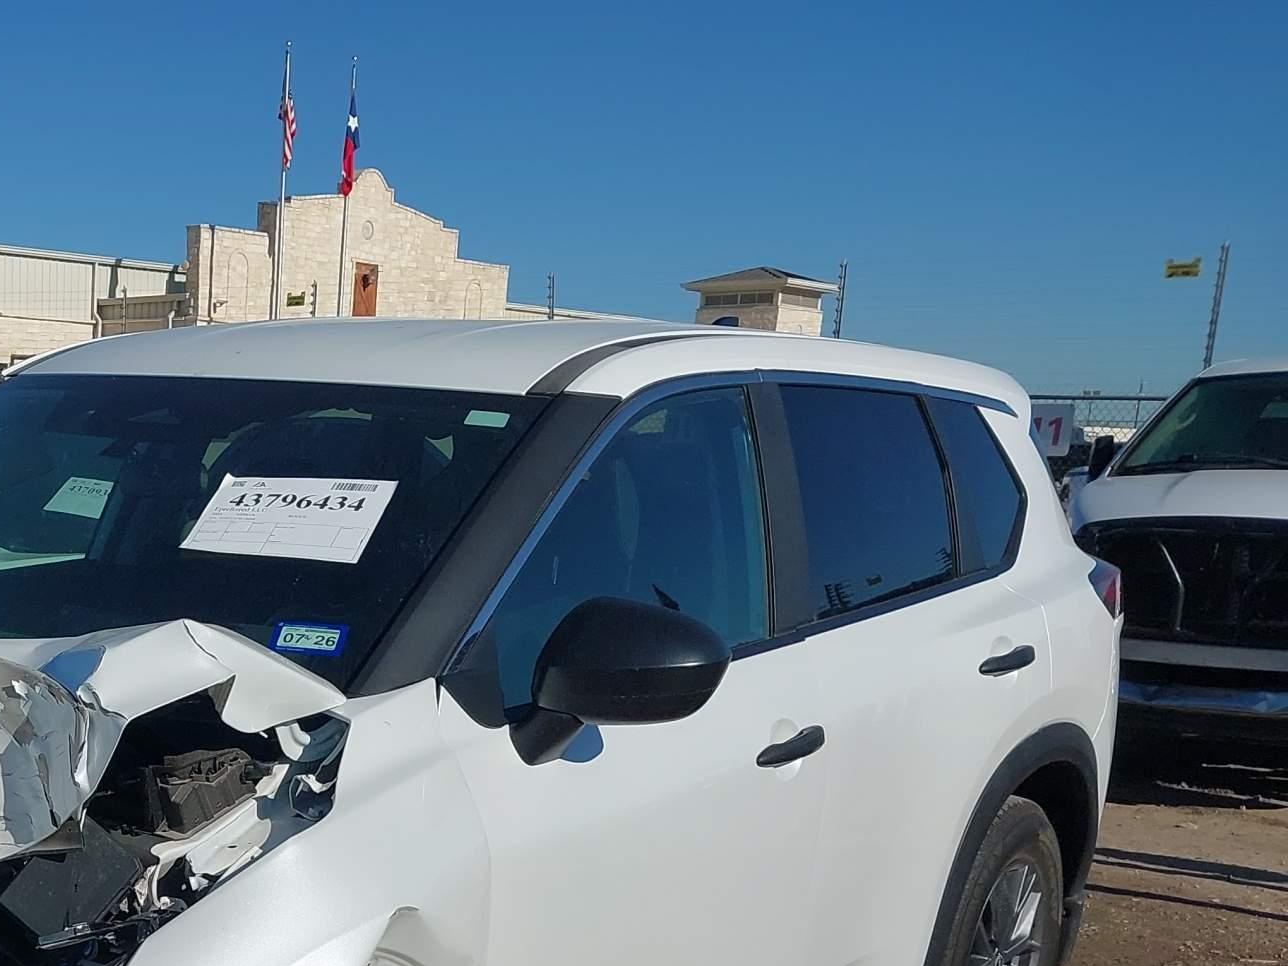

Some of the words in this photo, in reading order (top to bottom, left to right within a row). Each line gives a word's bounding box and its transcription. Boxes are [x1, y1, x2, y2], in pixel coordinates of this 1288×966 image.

[228, 492, 367, 512] 43796434
[282, 632, 306, 644] 07
[313, 635, 337, 647] 26
